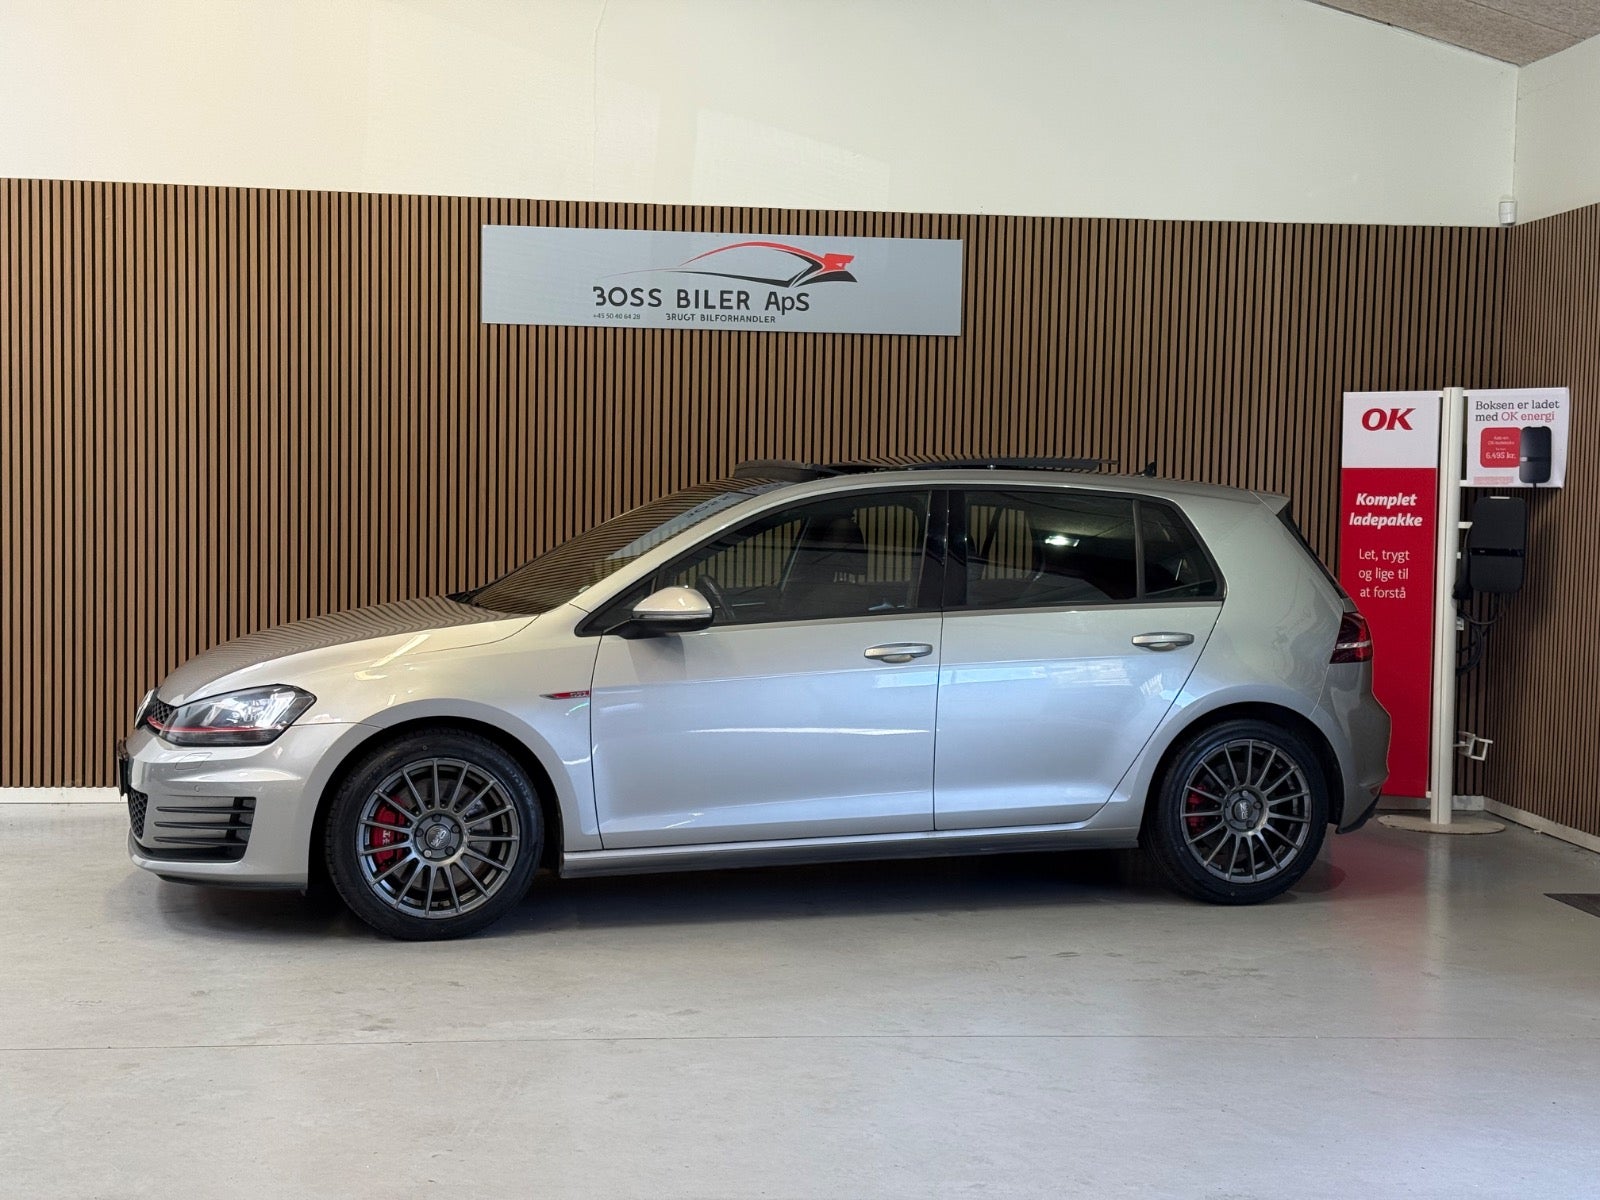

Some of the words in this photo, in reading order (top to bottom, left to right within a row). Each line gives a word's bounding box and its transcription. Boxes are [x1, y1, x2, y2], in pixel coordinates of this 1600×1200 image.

[676, 289, 750, 310] BILER
[764, 291, 810, 316] ApS
[700, 314, 776, 324] BILFORHANDLER
[1475, 401, 1515, 410] Boksen
[1517, 402, 1529, 410] er
[1531, 400, 1560, 409] ladet
[1361, 408, 1416, 431] OK
[1475, 412, 1499, 422] med
[1501, 411, 1519, 421] OK
[1521, 411, 1555, 423] energi
[1356, 492, 1418, 510] Komplet
[1349, 512, 1423, 530] ladepakke
[1359, 548, 1379, 562] Let,
[1382, 549, 1410, 564] trygt
[1358, 569, 1372, 582] og
[1375, 566, 1395, 582] lige
[1398, 567, 1409, 580] til
[1360, 587, 1371, 598] at
[1374, 585, 1406, 599] forstå
